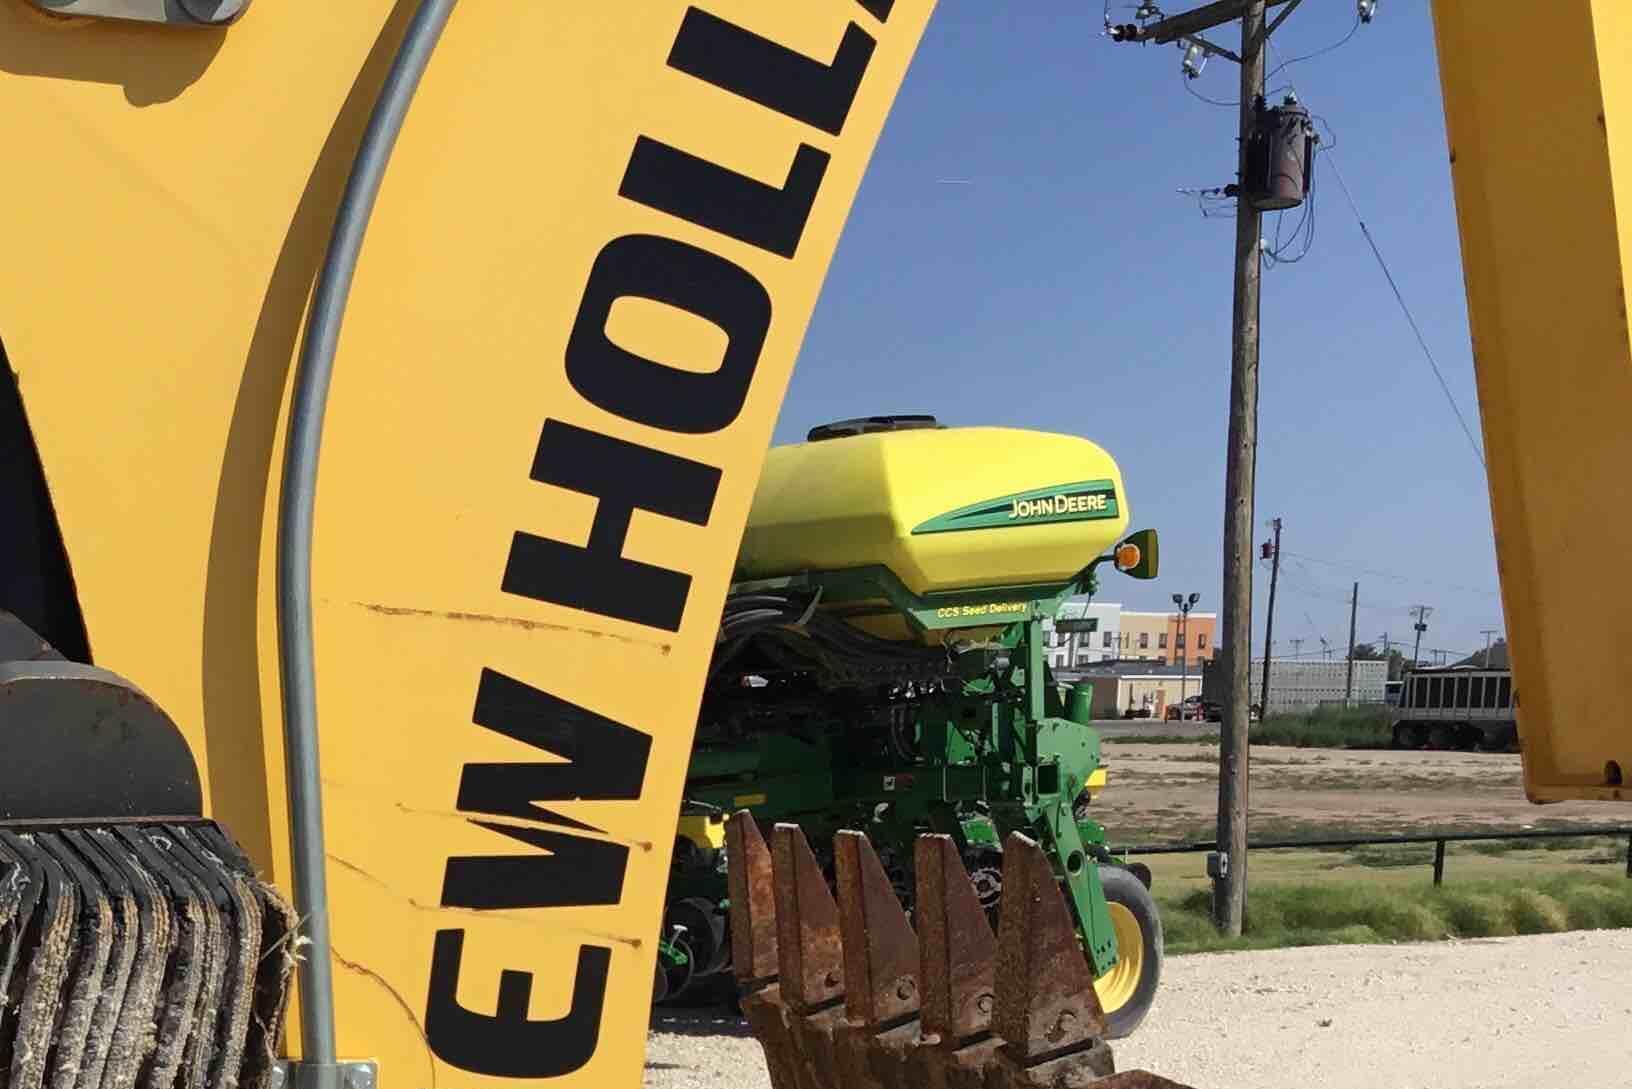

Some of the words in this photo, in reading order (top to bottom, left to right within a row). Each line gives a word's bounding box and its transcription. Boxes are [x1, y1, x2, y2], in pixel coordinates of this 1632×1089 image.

[501, 0, 895, 633] HOLL
[1008, 498, 1053, 519] JOHN
[1055, 494, 1108, 514] DEERE
[937, 606, 960, 618] CCS
[962, 604, 988, 616] Seed
[989, 602, 1028, 615] Delivery
